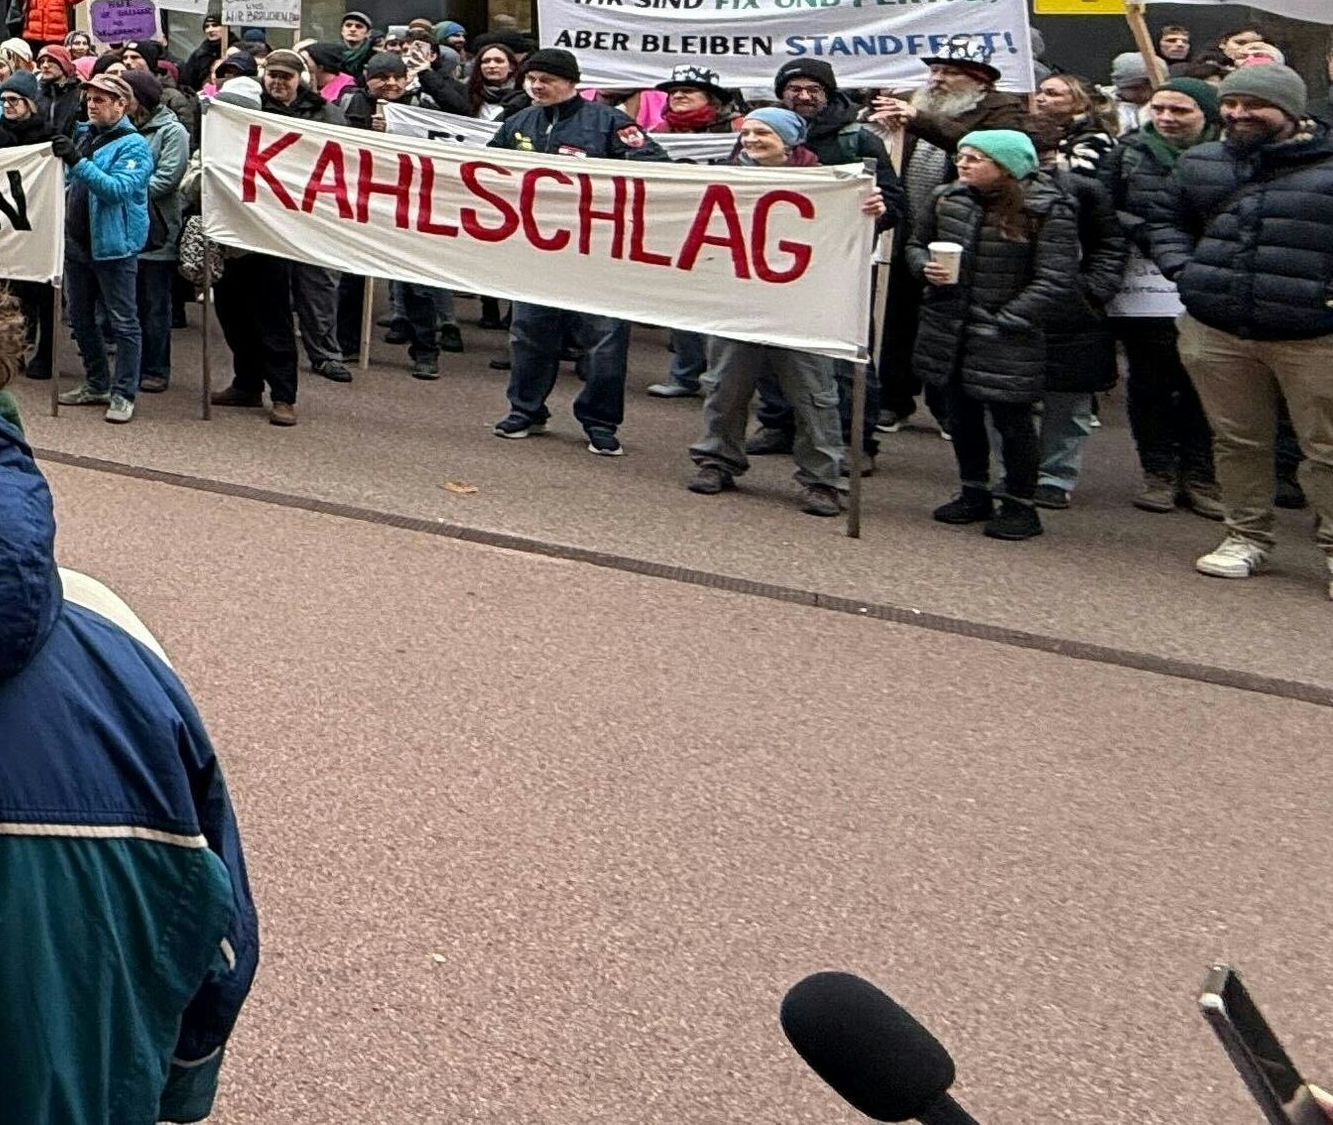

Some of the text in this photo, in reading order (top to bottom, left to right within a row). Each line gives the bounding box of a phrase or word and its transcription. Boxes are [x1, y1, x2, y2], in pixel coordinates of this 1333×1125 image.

[554, 29, 630, 52] ABER
[640, 32, 774, 56] BLEIBEN
[241, 125, 815, 283] KAHLSCHLAG
